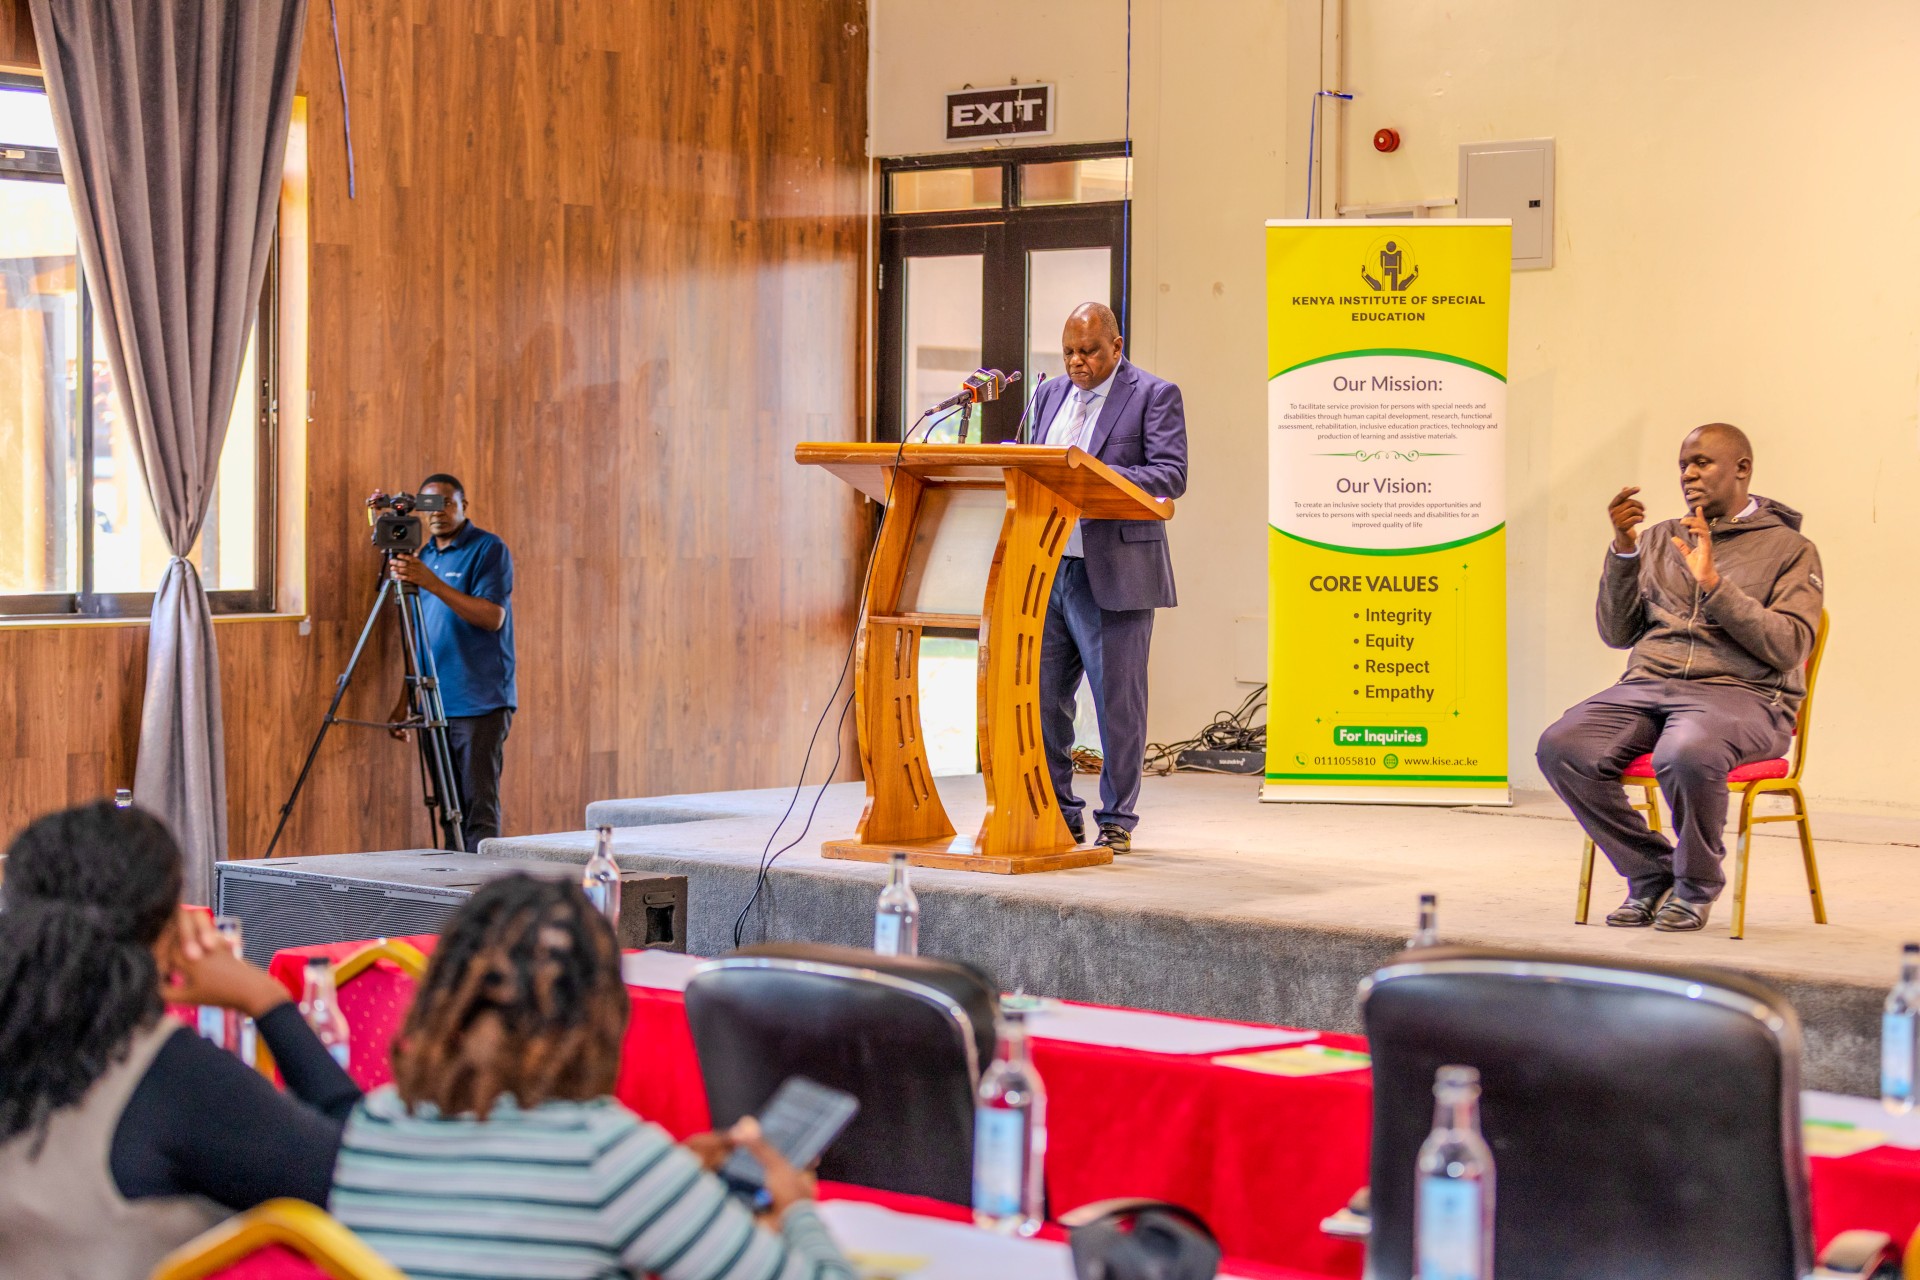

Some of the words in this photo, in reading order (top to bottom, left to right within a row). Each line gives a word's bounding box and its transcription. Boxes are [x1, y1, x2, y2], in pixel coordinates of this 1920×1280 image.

[952, 99, 1042, 127] EXIT
[1292, 296, 1335, 305] KENYA
[1339, 296, 1407, 305] INSTITUTE
[1411, 296, 1427, 304] OF
[1432, 296, 1486, 304] SPECIAL
[1352, 312, 1425, 321] EDUCATION
[1333, 376, 1366, 392] Our
[1372, 376, 1442, 392] Mission:
[1336, 478, 1370, 493] Our
[1373, 478, 1432, 493] Vision:
[1310, 576, 1362, 592] CORE
[1365, 576, 1439, 592] VALUES
[1365, 608, 1432, 626] Integrity
[1365, 634, 1414, 651] Equity
[1365, 660, 1430, 676] Respect
[1365, 685, 1434, 702] Empathy
[1340, 729, 1362, 742] For
[1364, 730, 1422, 745] Inquiries
[1314, 756, 1376, 766] 0111055810
[1404, 756, 1478, 766] www.kise.ac.ke
